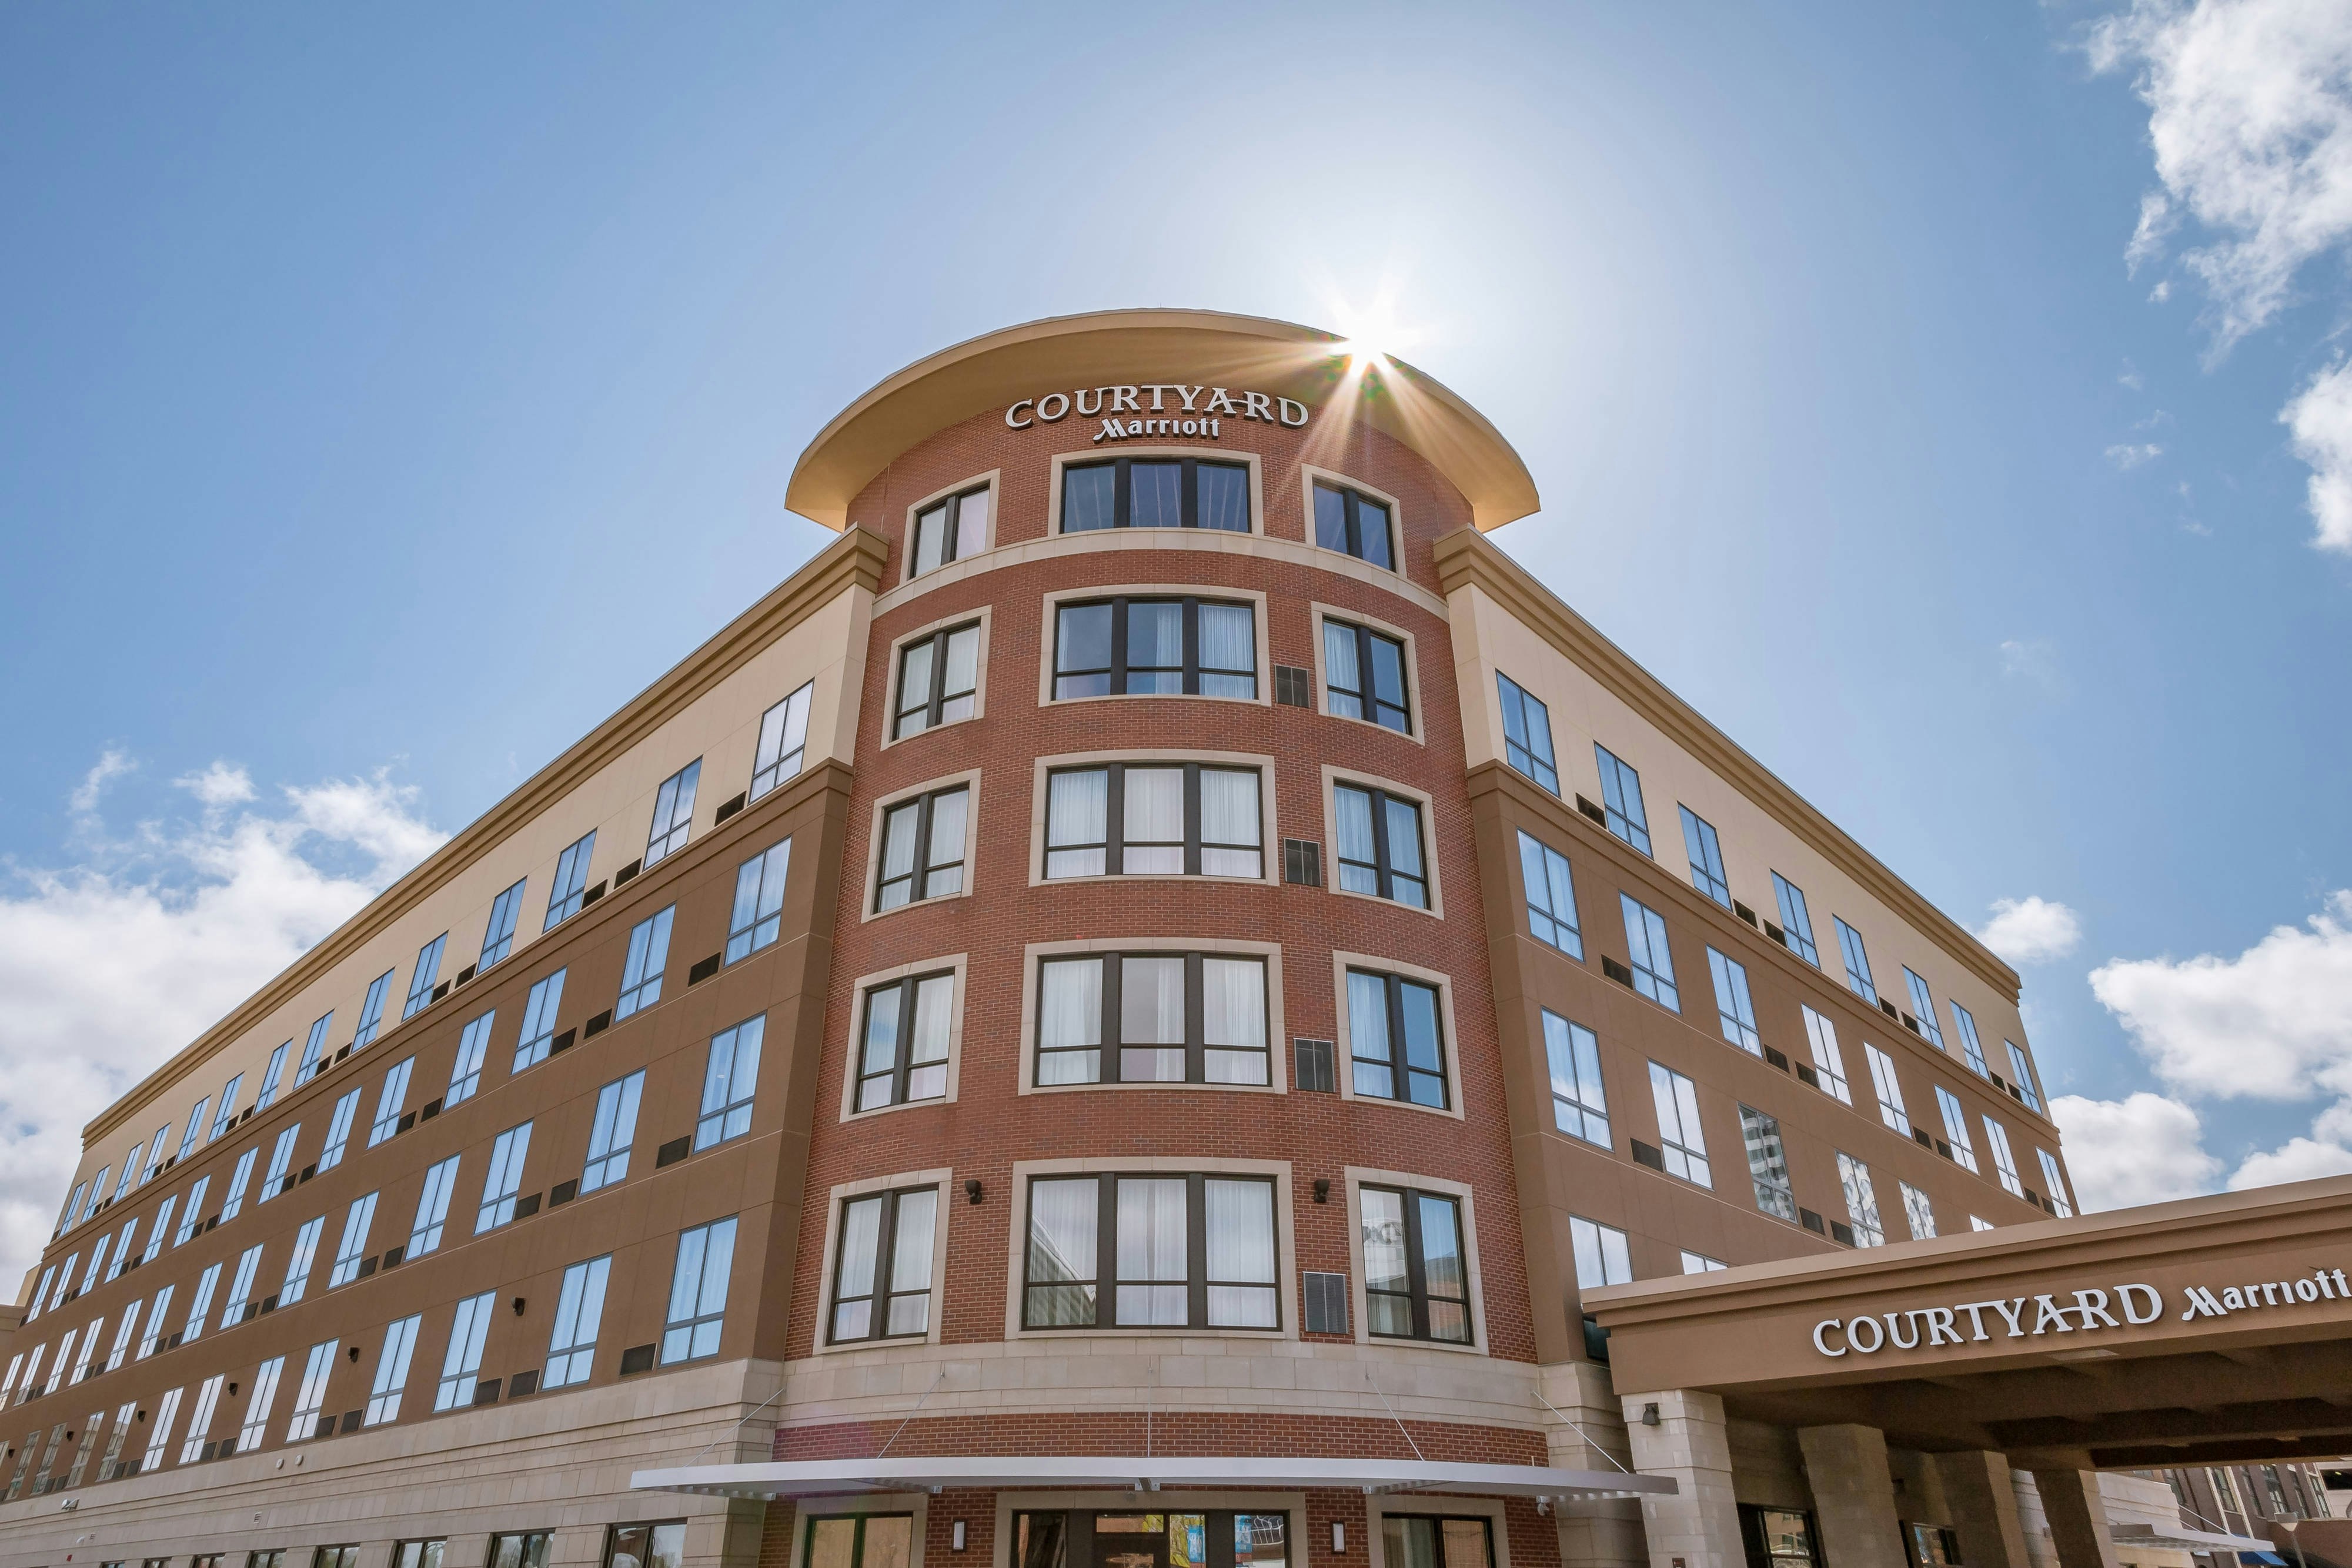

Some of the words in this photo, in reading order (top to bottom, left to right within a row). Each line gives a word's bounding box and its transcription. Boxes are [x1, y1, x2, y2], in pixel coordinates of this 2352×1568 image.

[1005, 385, 1309, 429] COURTYARD
[1093, 417, 1220, 443] Marriott
[1813, 1283, 2163, 1357] COURTYARD
[2181, 1268, 2352, 1321] Marriott
